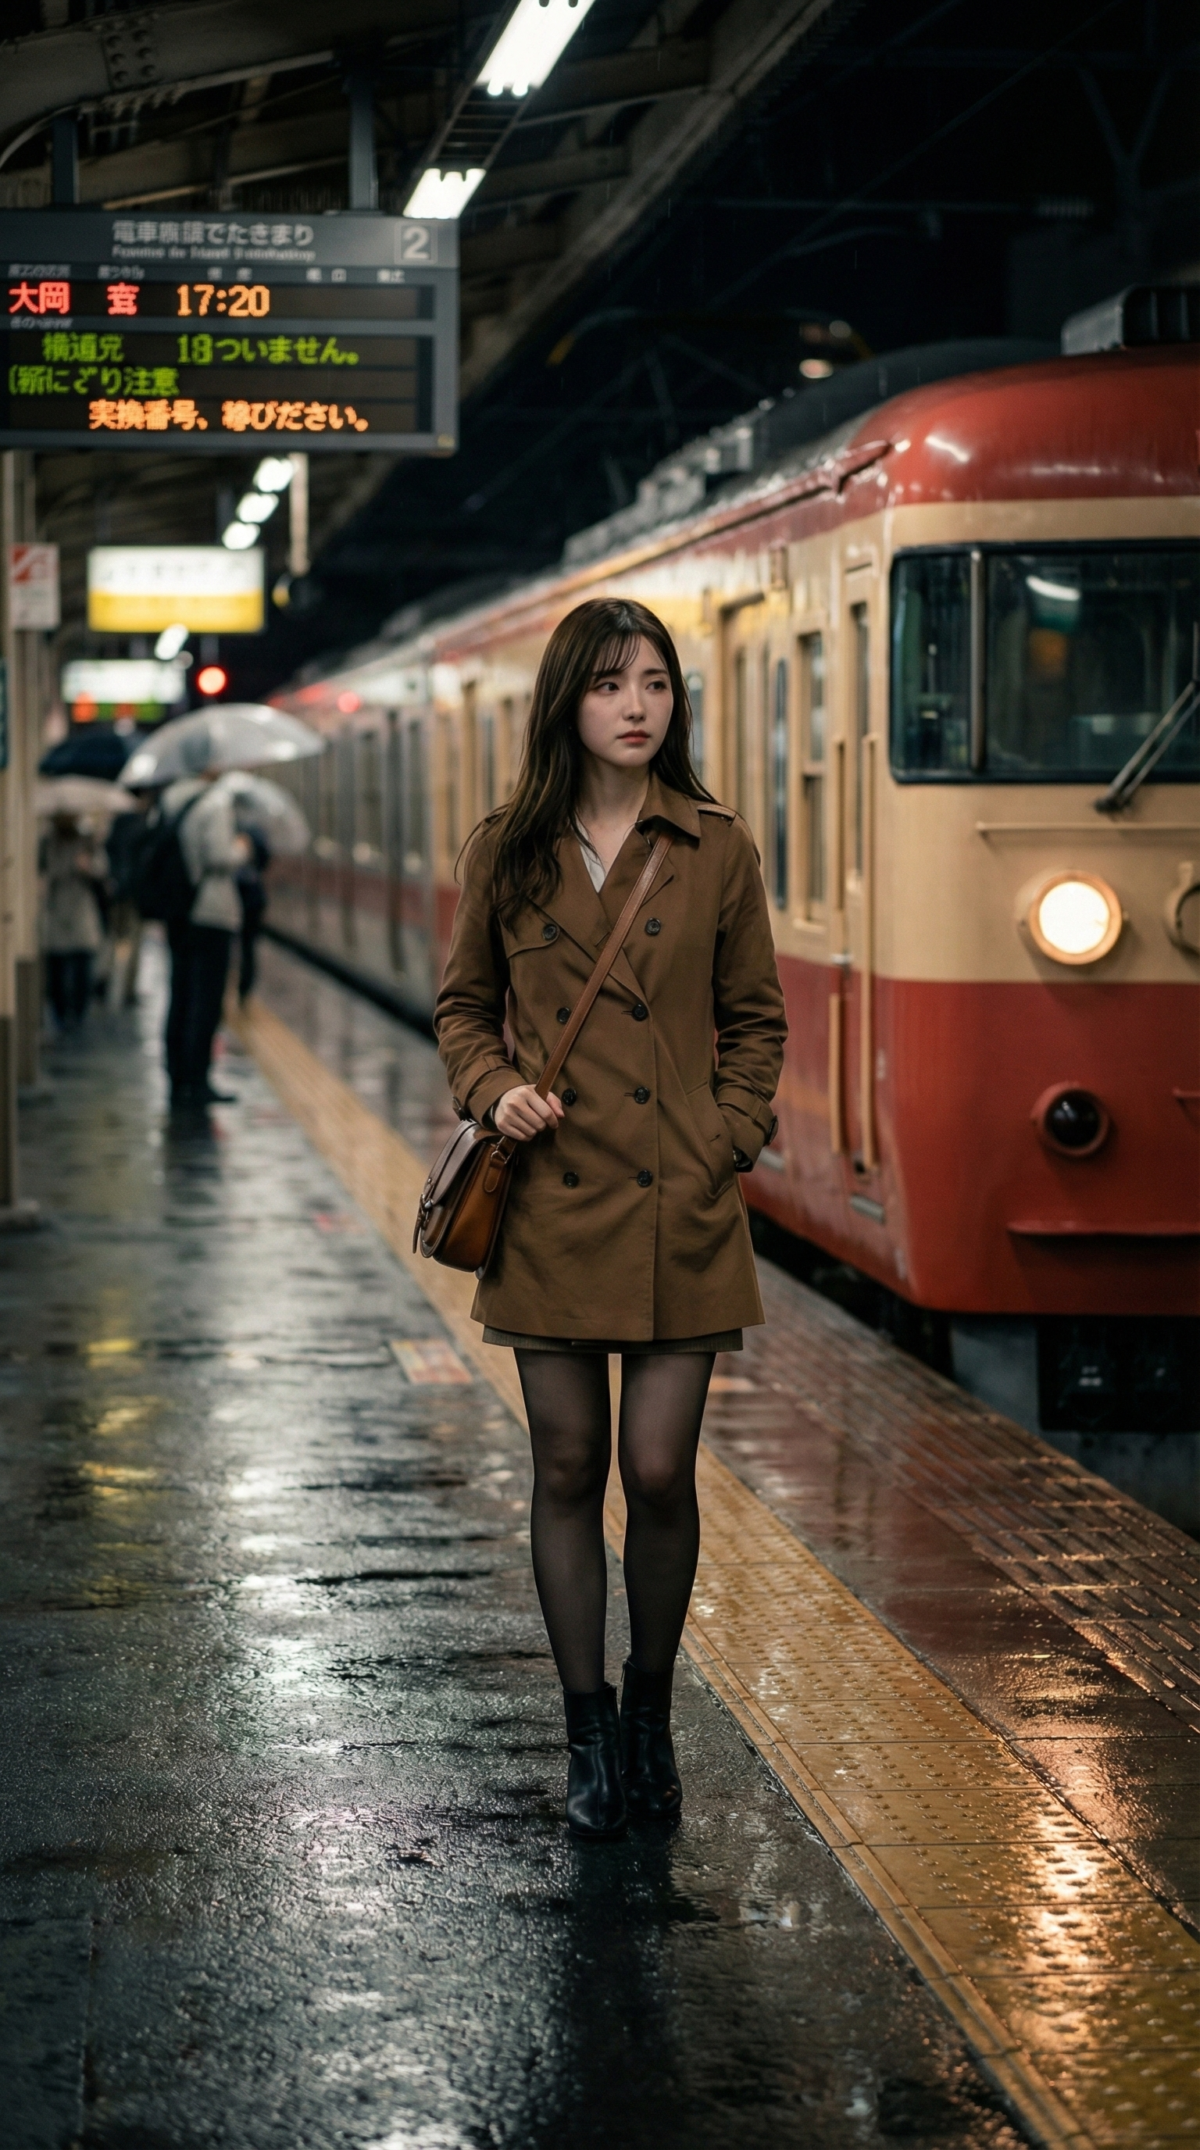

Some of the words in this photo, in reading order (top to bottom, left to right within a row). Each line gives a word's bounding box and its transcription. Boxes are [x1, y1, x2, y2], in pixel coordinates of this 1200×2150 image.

[403, 226, 429, 260] 2
[9, 281, 70, 314] 大岡
[176, 283, 270, 317] 17:20
